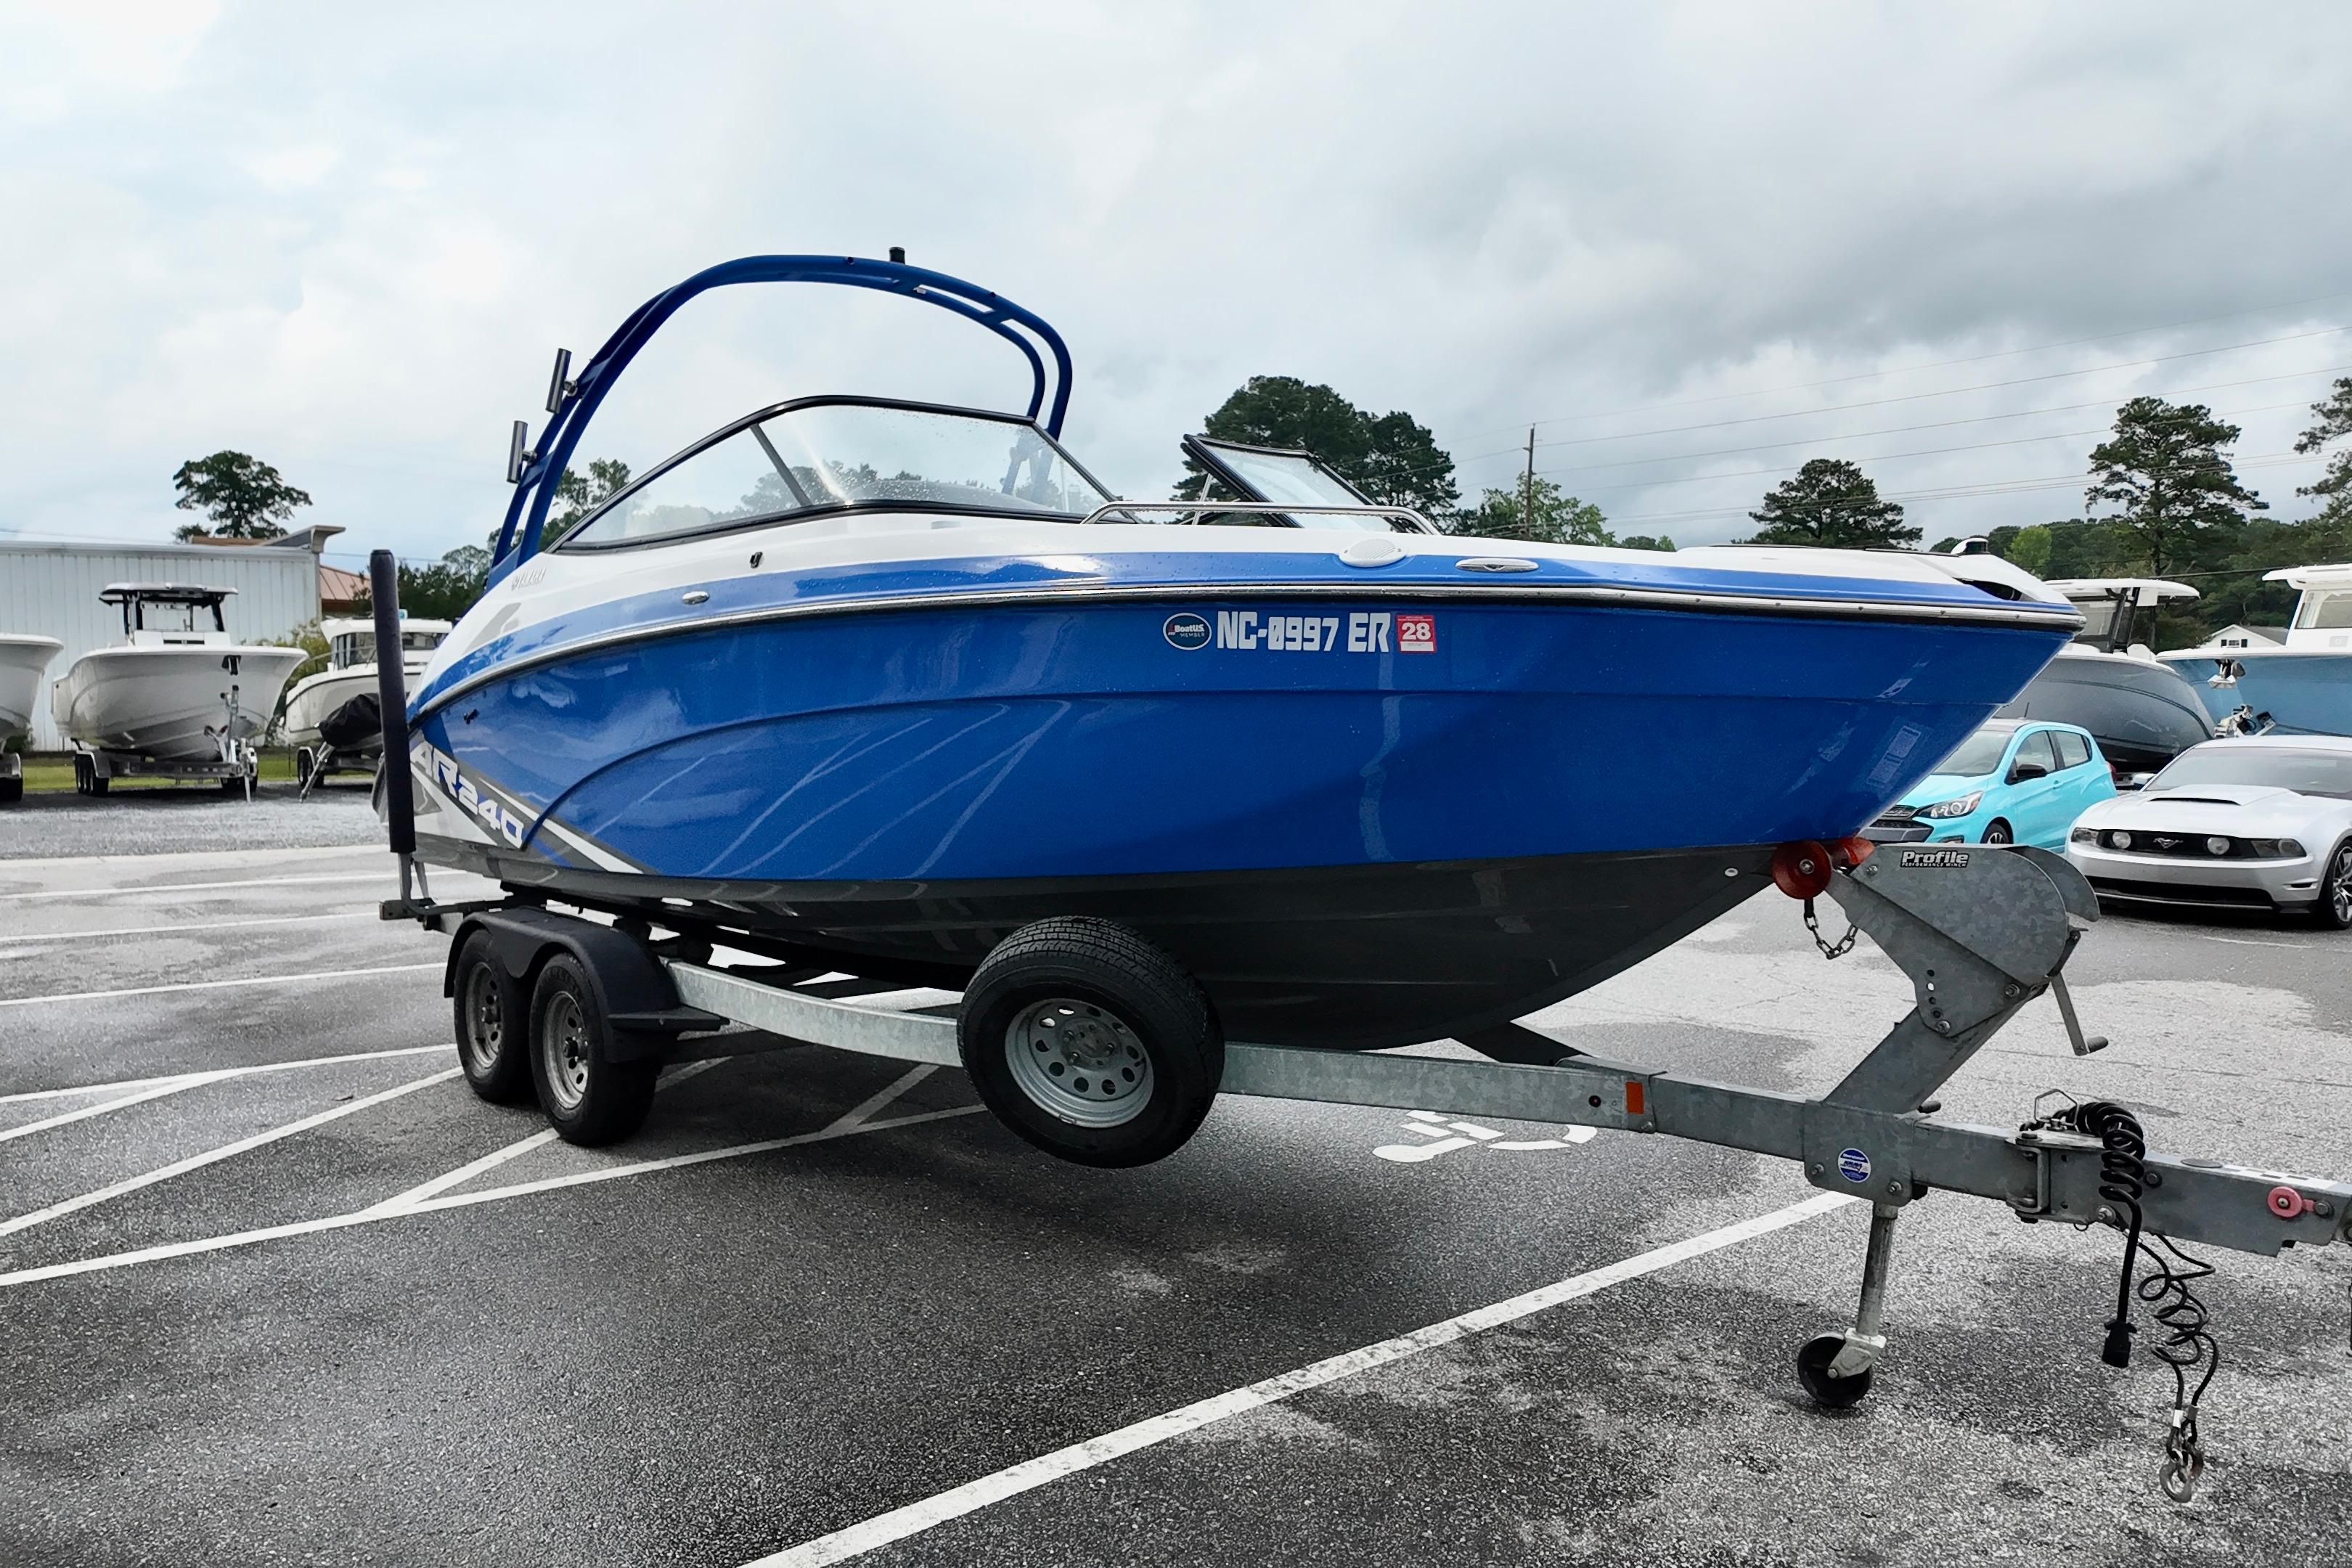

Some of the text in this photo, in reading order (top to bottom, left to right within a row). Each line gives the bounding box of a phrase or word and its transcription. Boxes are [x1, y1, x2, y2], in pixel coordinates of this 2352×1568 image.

[1217, 611, 1392, 653] NC-0997 ER
[1401, 622, 1432, 640] 28
[1902, 851, 1969, 863] Profile
